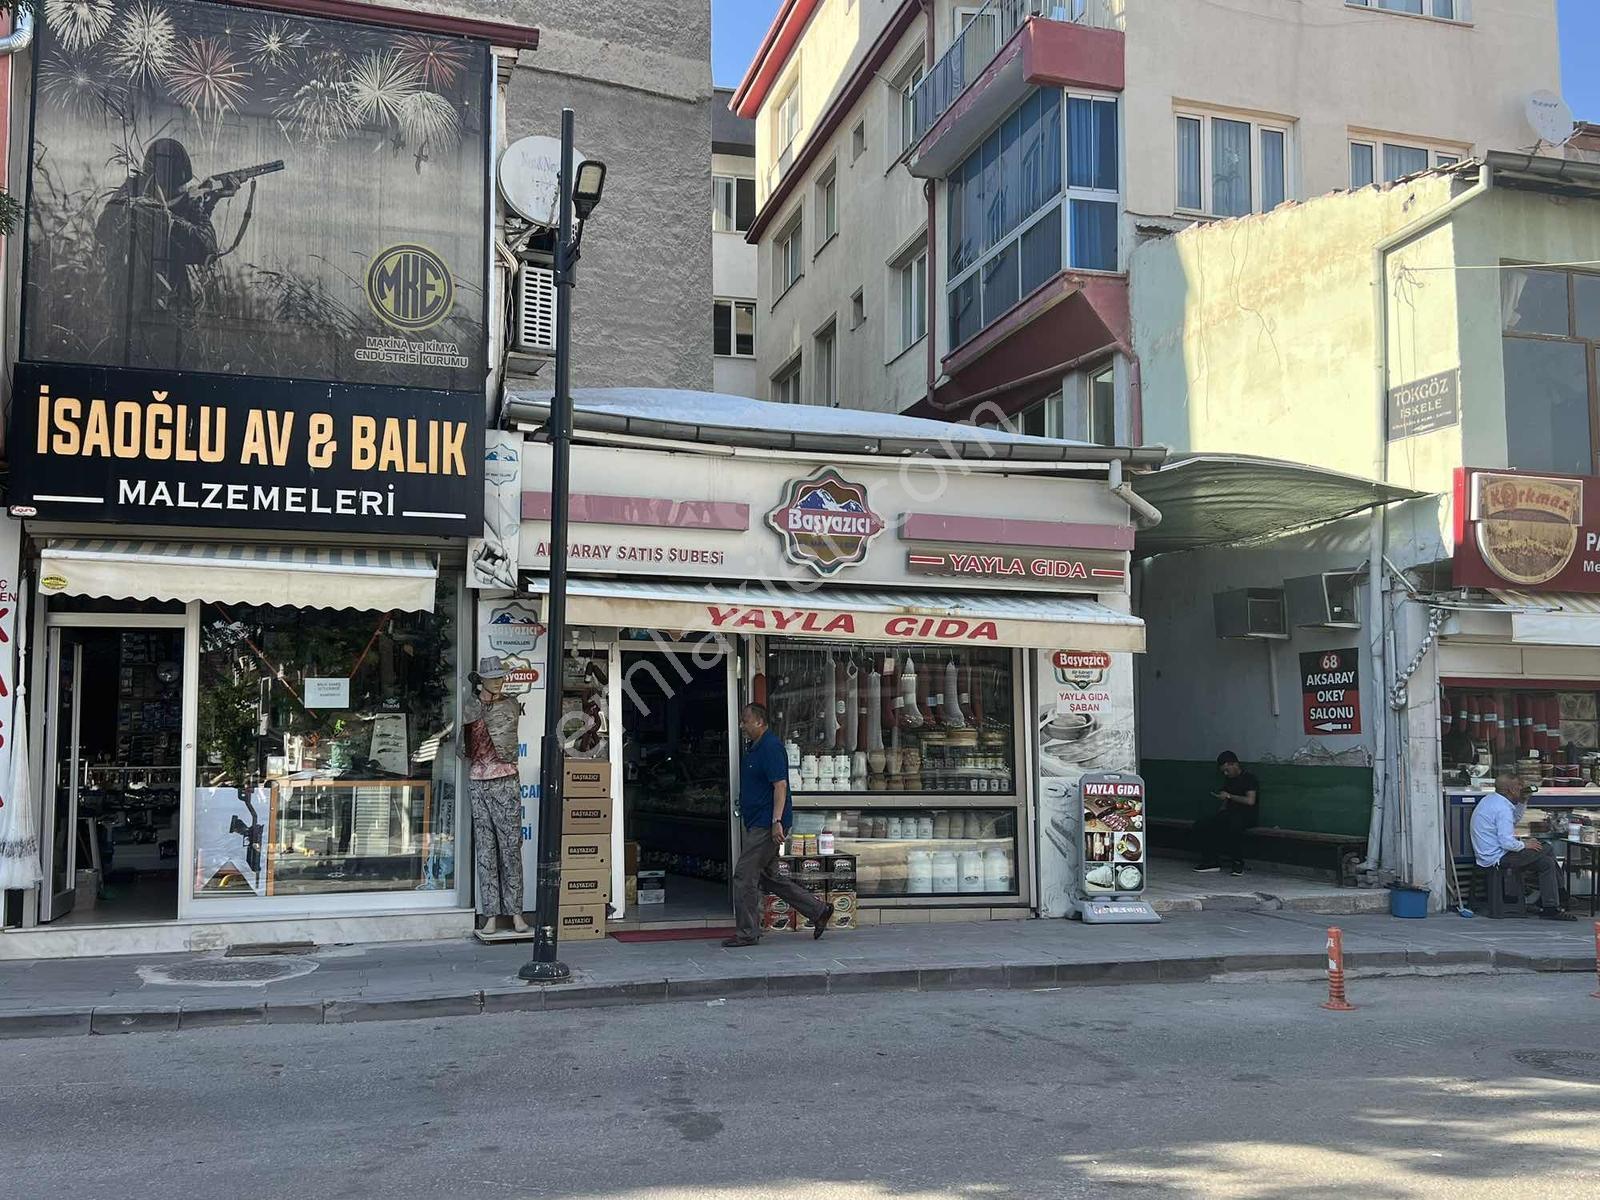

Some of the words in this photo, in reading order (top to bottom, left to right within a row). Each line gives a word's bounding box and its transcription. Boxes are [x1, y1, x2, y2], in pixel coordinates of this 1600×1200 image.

[378, 254, 441, 319] MKE
[367, 336, 407, 350] MAKİNA
[426, 340, 457, 354] KİMYA
[356, 350, 420, 364] ENDÜSTRİSİ
[422, 355, 468, 367] KURUMU
[1394, 377, 1449, 407] TOKGÖZ
[36, 385, 227, 462] İSAOĞLU
[240, 409, 294, 467] AV
[307, 413, 337, 470] &
[352, 415, 468, 476] BALIK
[118, 479, 396, 517] MALZEMELERİ
[950, 554, 1025, 575] YAYLA
[1030, 559, 1087, 578] GIDA
[707, 606, 855, 633] YAYLA
[884, 617, 998, 640] GIDA
[1322, 655, 1338, 669] 68
[1306, 671, 1355, 686] AKSARAY
[1059, 692, 1087, 701] YAYLA
[1089, 693, 1109, 701] GIDA
[1317, 689, 1345, 702] OKEY
[1069, 703, 1100, 713] ŞABAN
[1310, 706, 1354, 720] SALONU
[1085, 783, 1115, 795] YAYLA
[1116, 784, 1140, 795] GIDA
